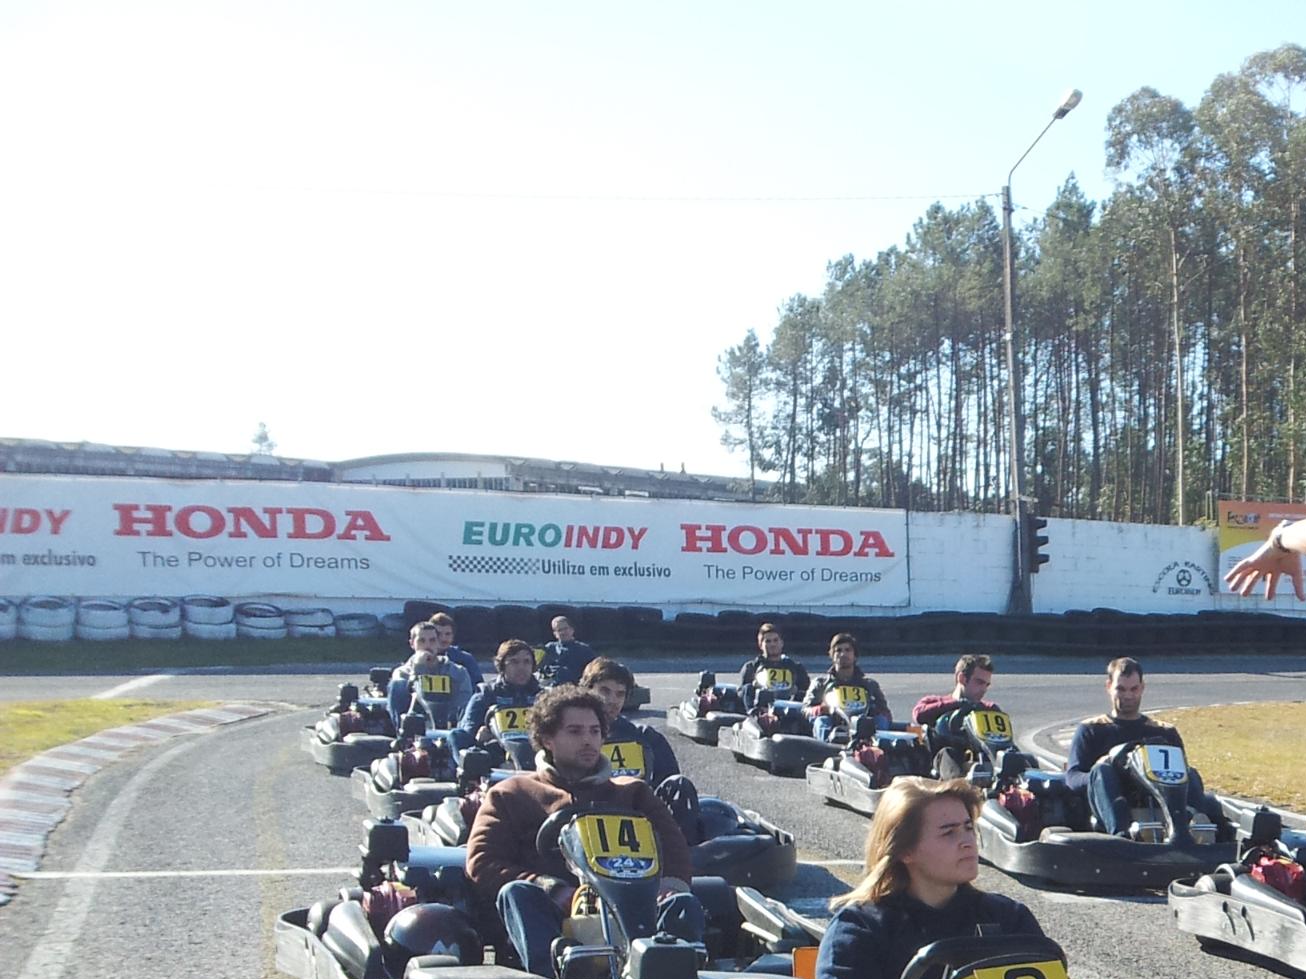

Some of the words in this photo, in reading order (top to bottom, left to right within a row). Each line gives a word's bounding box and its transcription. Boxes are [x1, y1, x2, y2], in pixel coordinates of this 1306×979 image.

[112, 503, 391, 542] HONDA
[462, 520, 649, 551] EUROINDY
[680, 523, 895, 558] HONDA
[22, 549, 97, 567] exclusivo
[137, 551, 180, 568] The
[188, 551, 256, 569] Power
[262, 551, 282, 569] of
[289, 552, 371, 570] Dreams
[541, 558, 586, 576] Utiliza
[589, 564, 610, 576] em
[613, 561, 672, 578] exclusivo
[703, 564, 736, 580] The
[742, 565, 796, 581] Power
[800, 567, 817, 582] of
[821, 568, 883, 583] Dreams
[769, 669, 787, 682] 21
[842, 686, 861, 702] 13
[983, 713, 1007, 733] 19
[610, 744, 627, 769] 4
[596, 818, 641, 853] 14
[612, 857, 635, 868] 24
